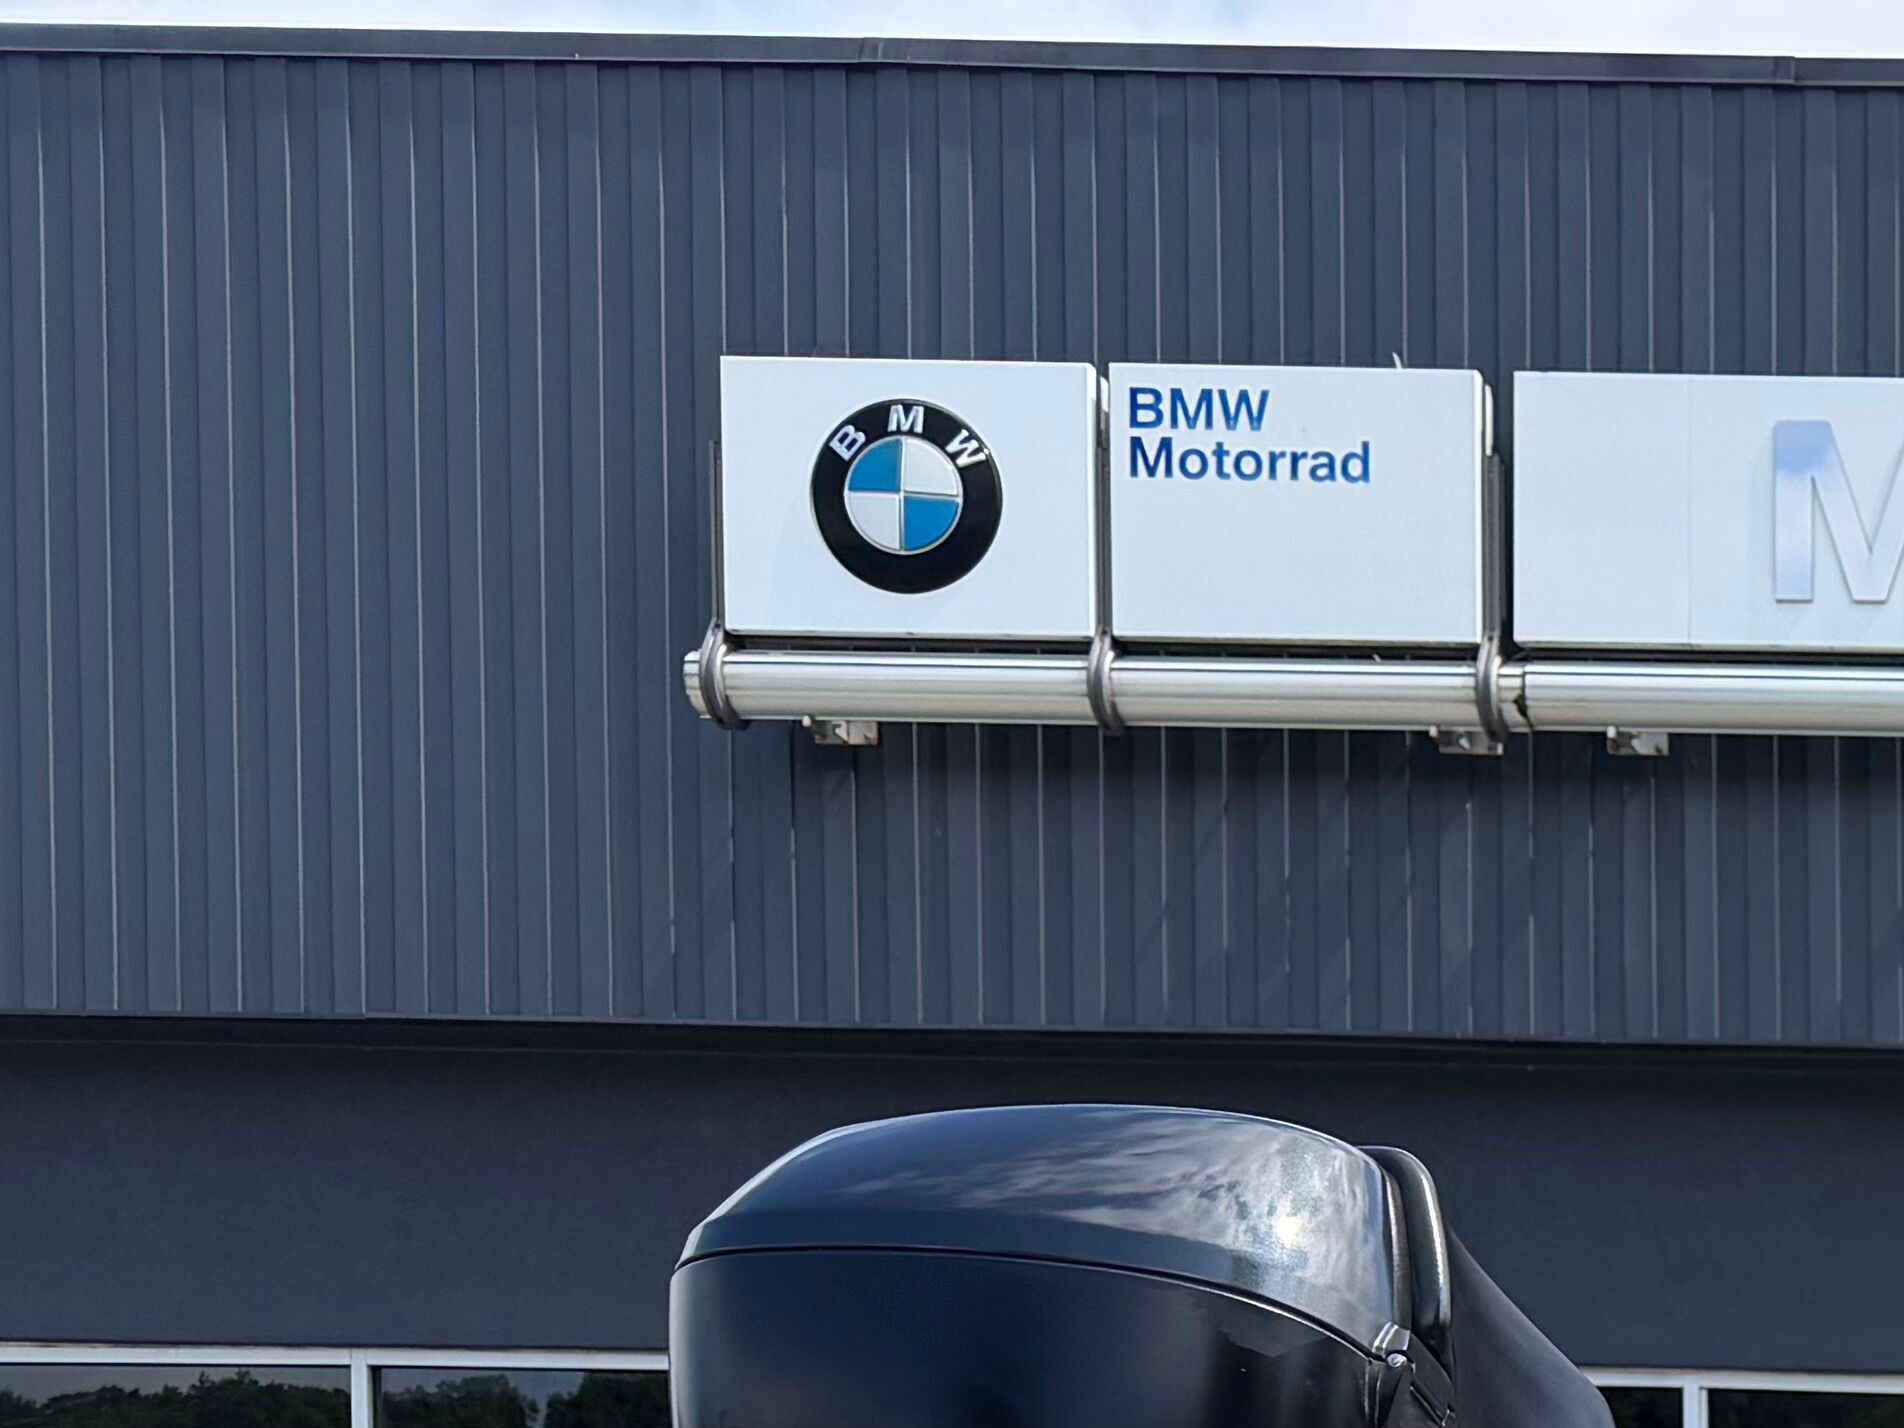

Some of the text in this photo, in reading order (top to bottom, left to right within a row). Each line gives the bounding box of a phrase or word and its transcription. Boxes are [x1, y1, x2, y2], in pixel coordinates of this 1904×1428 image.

[1129, 386, 1270, 431] BMW
[829, 404, 987, 468] BMW
[1129, 437, 1370, 483] Motorrad
